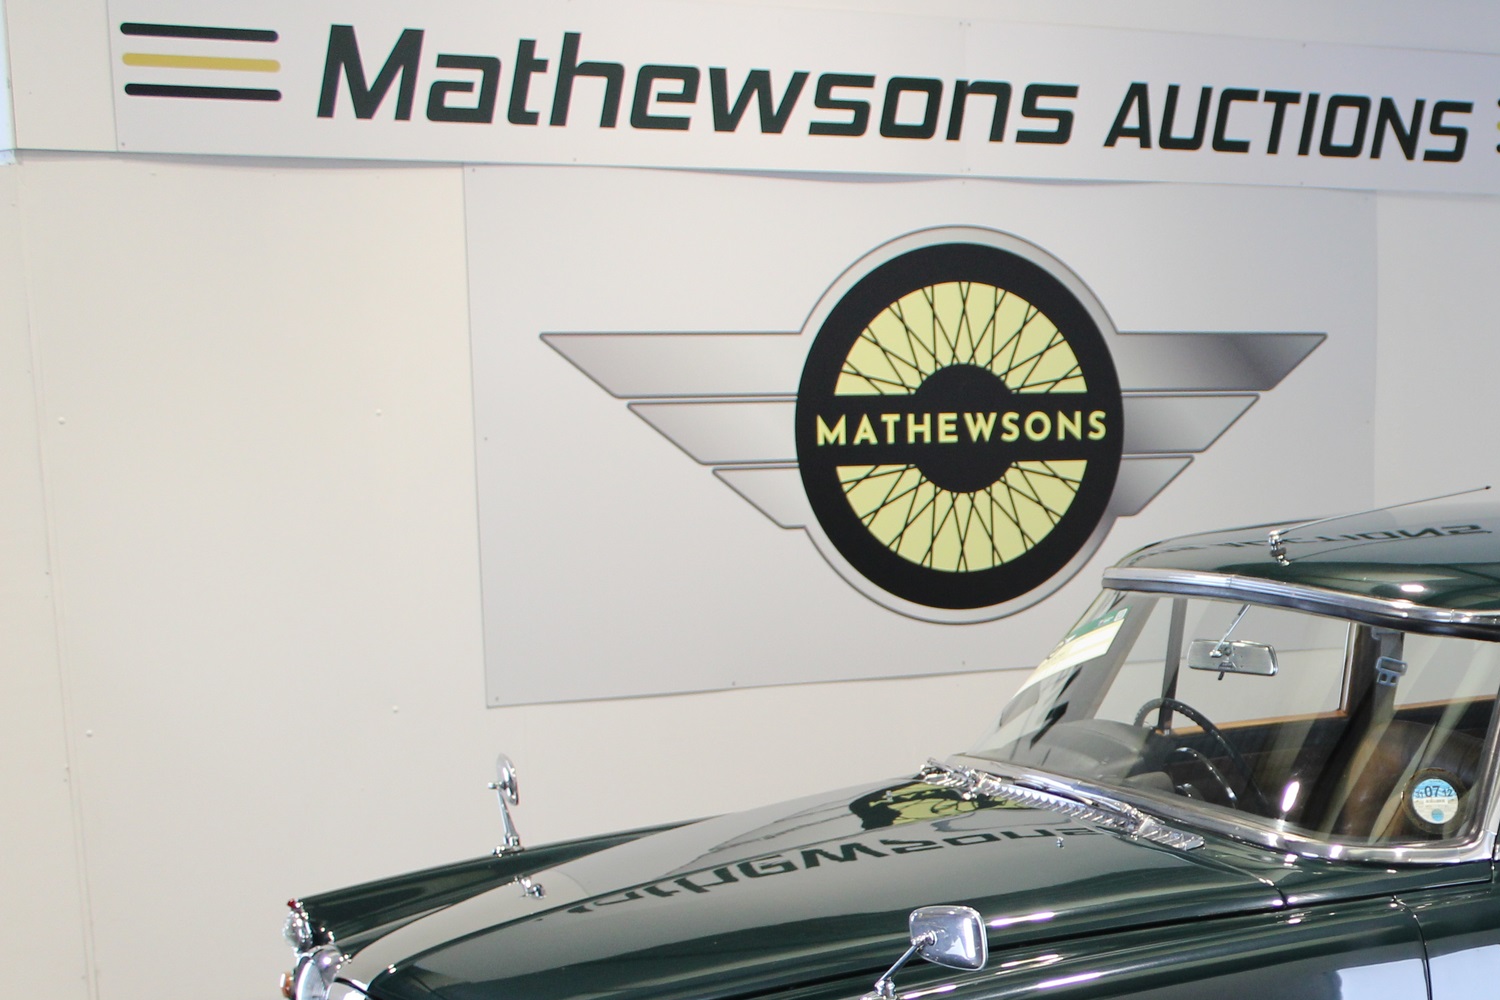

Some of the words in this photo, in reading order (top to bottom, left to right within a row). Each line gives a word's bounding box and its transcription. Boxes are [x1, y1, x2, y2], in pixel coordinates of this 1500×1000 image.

[317, 24, 1079, 145] Mathewsons
[1103, 82, 1474, 163] AUCTIONS
[815, 409, 1108, 447] MATHEWSONS
